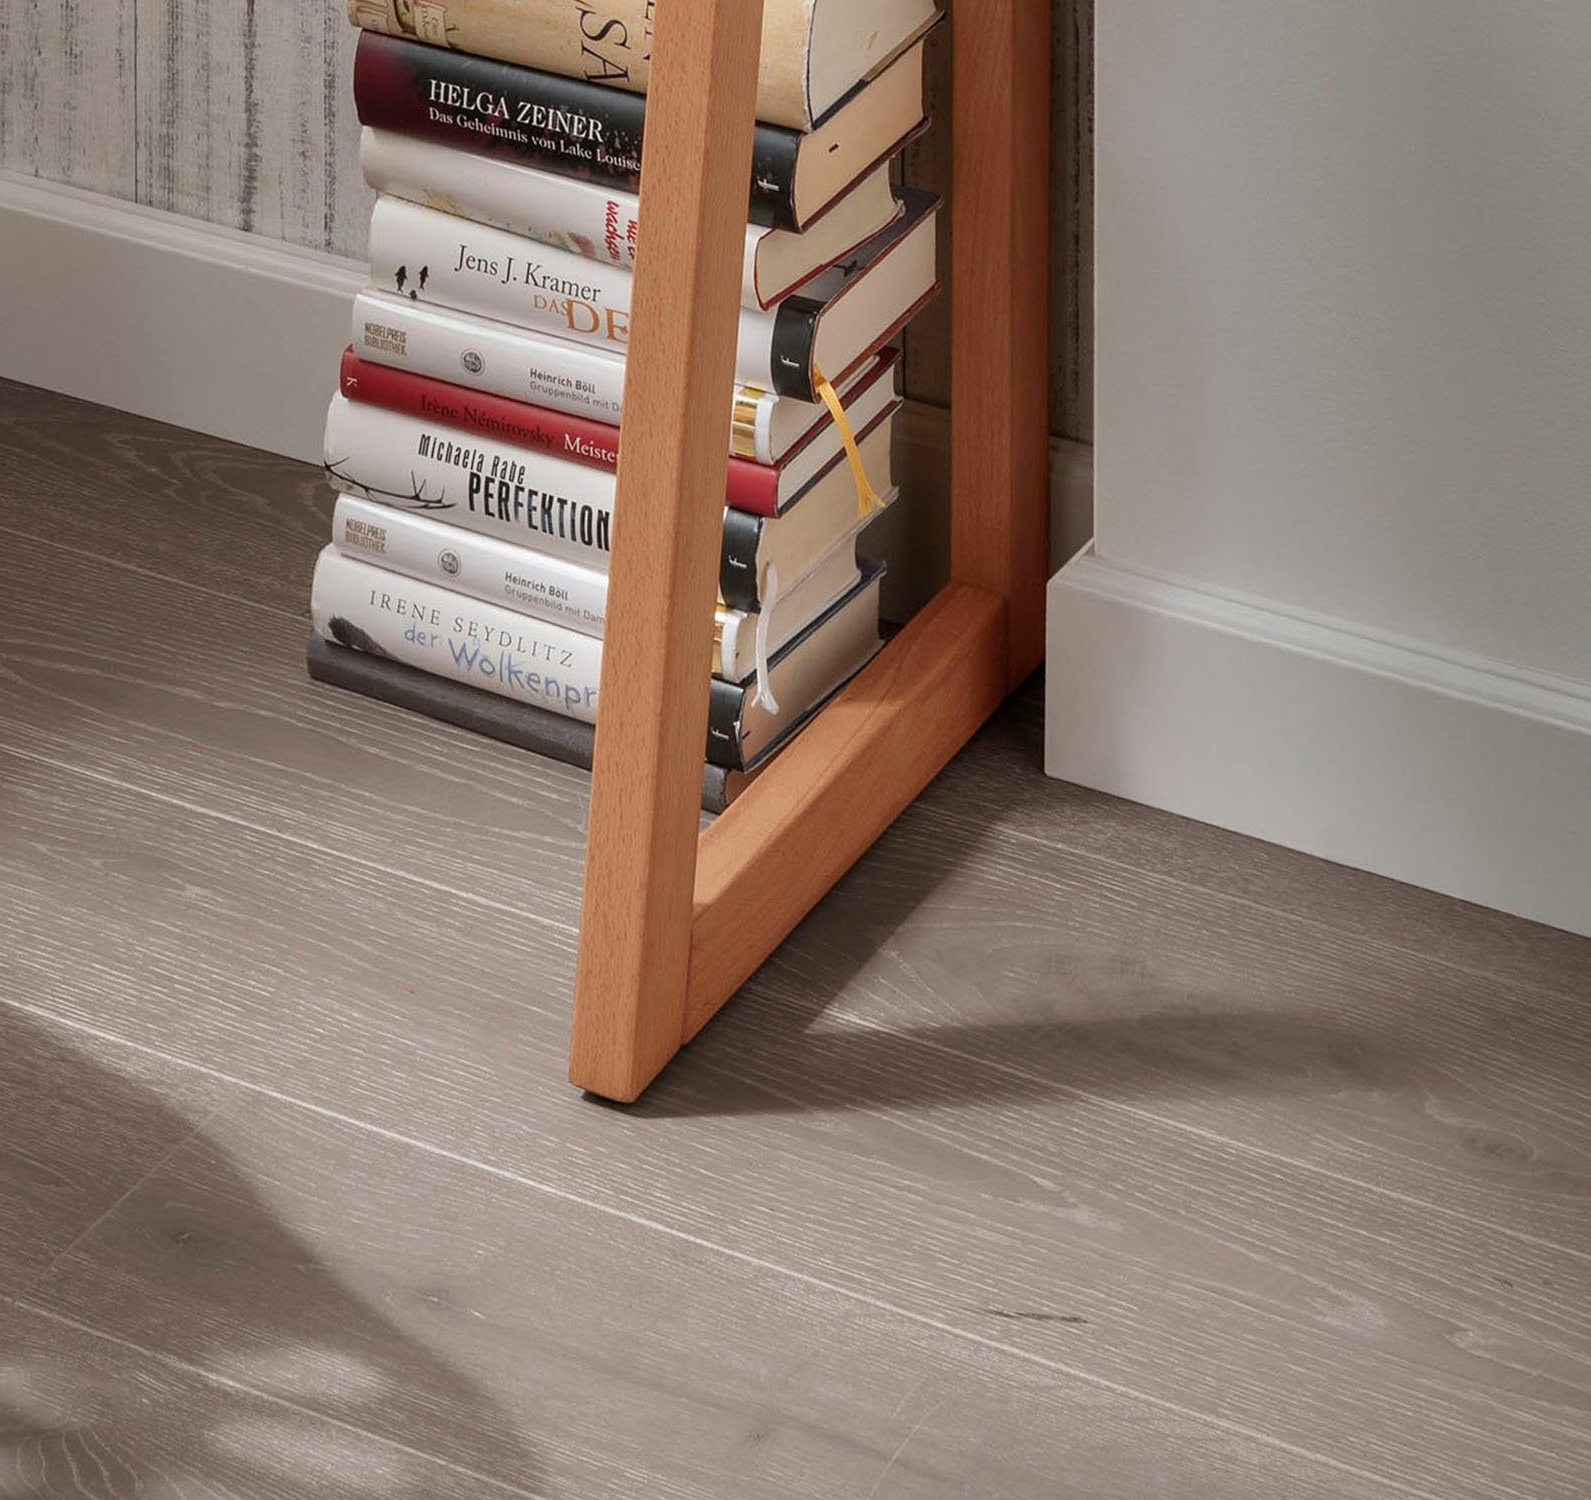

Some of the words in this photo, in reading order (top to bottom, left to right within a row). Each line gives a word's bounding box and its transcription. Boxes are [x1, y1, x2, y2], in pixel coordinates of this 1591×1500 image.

[428, 79, 510, 120] HELGA
[516, 101, 604, 142] ZEINER
[429, 107, 454, 125] Das
[456, 114, 528, 144] Geheimnis
[531, 135, 556, 150] von
[560, 139, 592, 160] Lake
[596, 148, 641, 171] Louise
[455, 244, 498, 276] Jens
[501, 257, 517, 284] J.
[524, 262, 601, 302] Kramer
[534, 294, 568, 316] DAS
[529, 368, 573, 388] Heinrich
[575, 378, 596, 395] Böll
[529, 380, 590, 405] Gruppenbild
[592, 396, 611, 411] mit
[421, 395, 459, 419] Irène
[462, 407, 554, 447] Némirovsky
[417, 434, 484, 473] Michaela
[468, 471, 610, 552] PERFEKTION
[504, 585, 562, 612] Gruppenbild
[564, 603, 581, 617] mit
[505, 572, 546, 594] Heinrich
[370, 590, 441, 626] IRENE
[453, 617, 573, 668] SEYDLITZ
[404, 624, 439, 648] der
